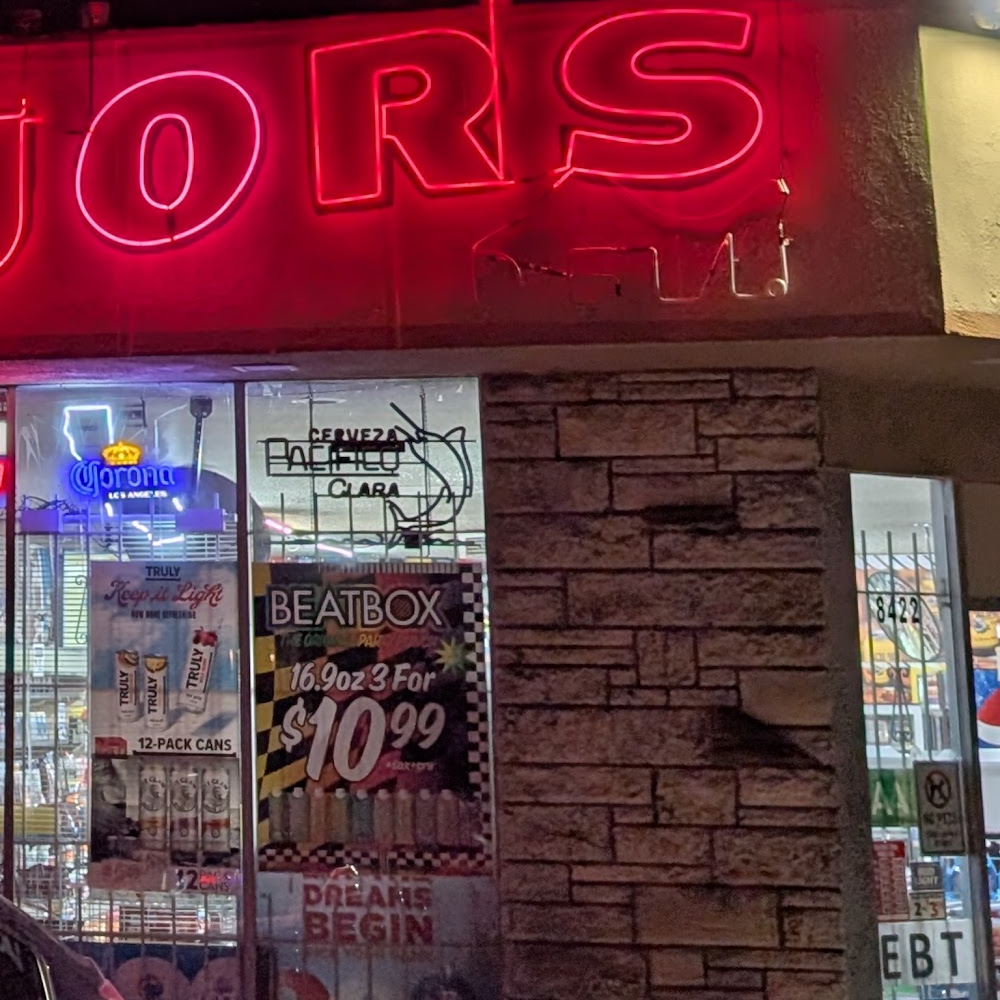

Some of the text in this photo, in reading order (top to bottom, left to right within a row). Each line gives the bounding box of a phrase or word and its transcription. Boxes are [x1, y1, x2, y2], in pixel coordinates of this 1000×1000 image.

[309, 428, 397, 442] CERVEZA
[265, 437, 401, 477] PACIFICO
[70, 461, 176, 497] Corona
[327, 478, 400, 499] CLARA
[145, 565, 181, 577] TRULY
[104, 580, 147, 607] Keep
[172, 582, 224, 610] Light
[271, 589, 443, 627] BEATBOX
[876, 597, 919, 624] 8422
[186, 648, 205, 689] TRULY
[290, 662, 437, 692] 16.9oz 3 For
[119, 671, 129, 706] TRULY
[148, 676, 158, 714] TRULY
[138, 738, 232, 751] 12-PACK CANS
[303, 883, 433, 909] DREAMS
[305, 911, 434, 947] BEGIN
[881, 931, 964, 980] EBT
